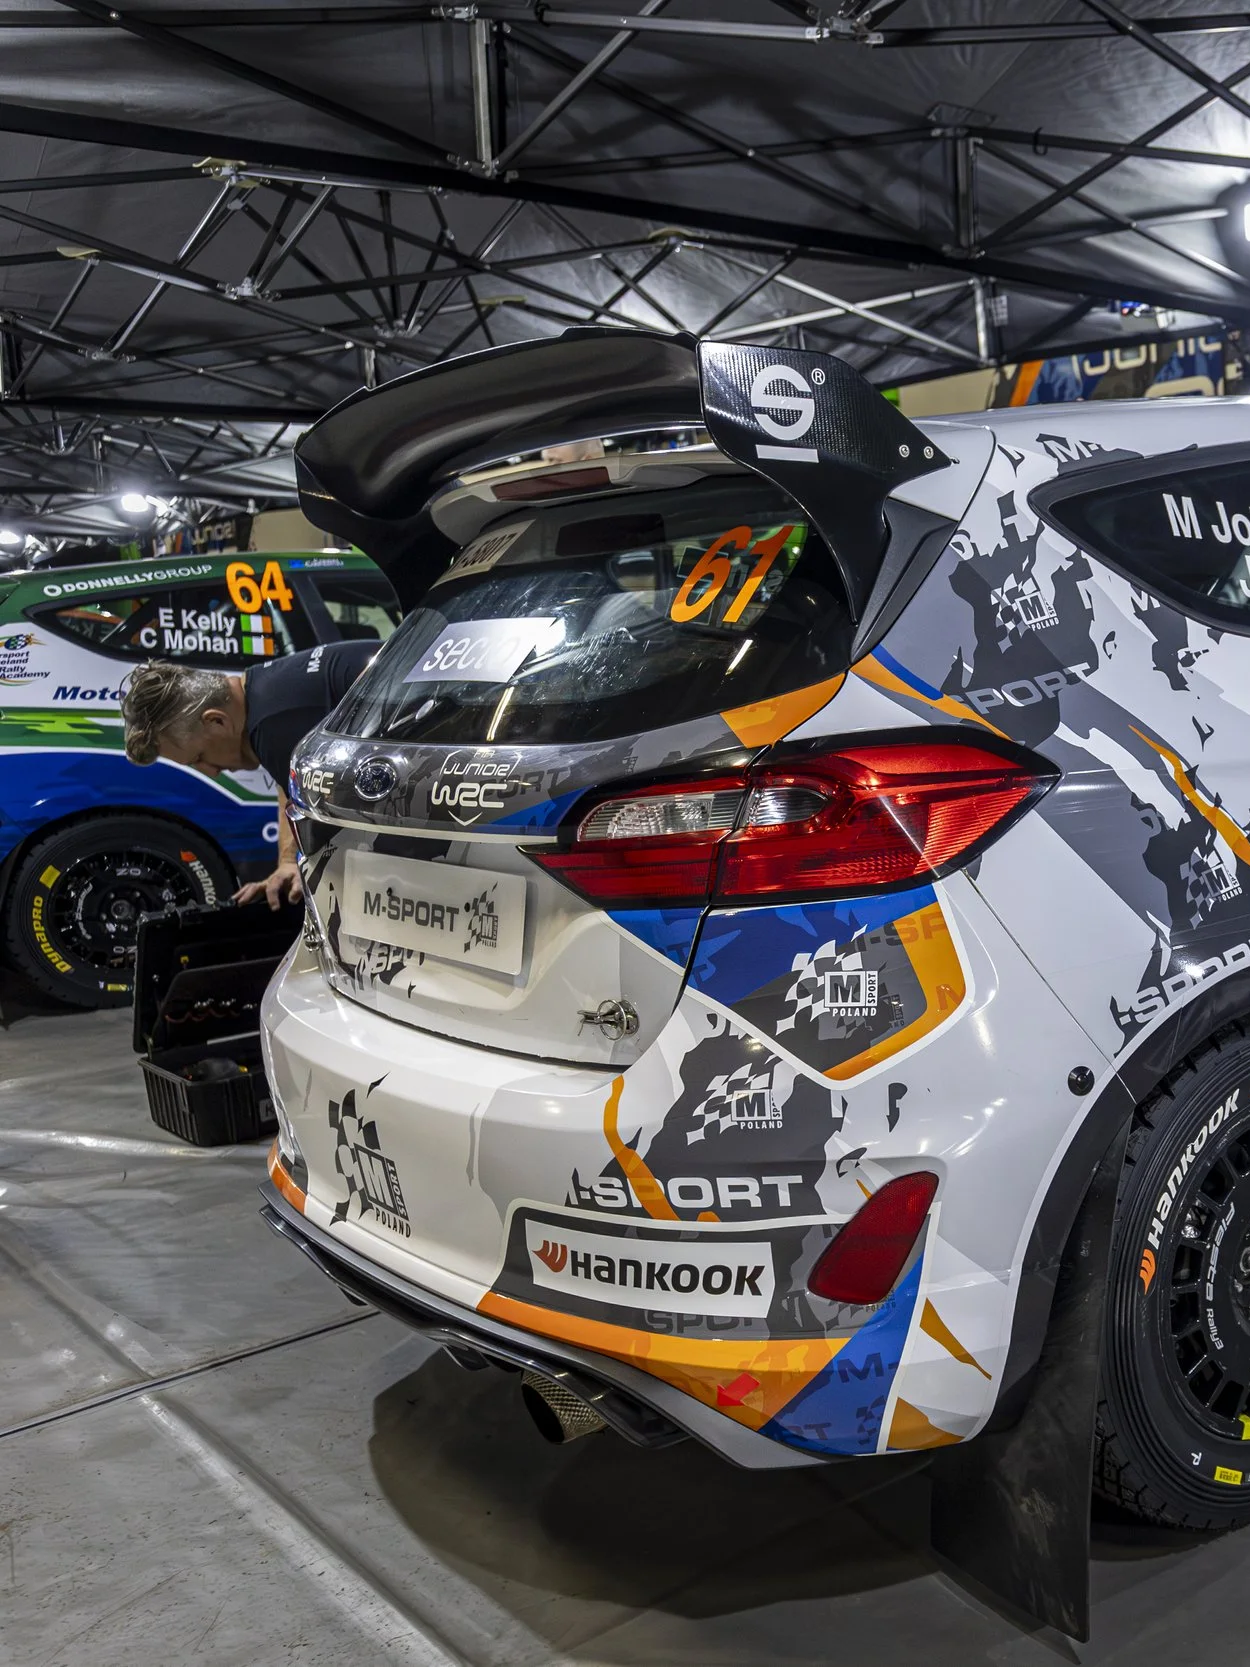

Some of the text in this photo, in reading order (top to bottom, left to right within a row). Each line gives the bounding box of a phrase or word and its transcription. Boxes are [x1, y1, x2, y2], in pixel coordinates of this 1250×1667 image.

[1162, 493, 1202, 539] M
[226, 560, 294, 614] 64
[670, 525, 796, 623] 61
[158, 607, 236, 634] E Kelly
[1031, 617, 1060, 631] POLAND
[139, 627, 239, 654] C Mohan
[443, 763, 511, 777] JUNIOR
[431, 781, 508, 808] WRC
[363, 890, 460, 933] M-SPORT
[867, 973, 877, 1004] SPORT
[832, 1007, 878, 1017] POLAND
[740, 1121, 783, 1129] POLAND
[388, 1163, 409, 1217] SPORT
[376, 1207, 411, 1238] POLAND
